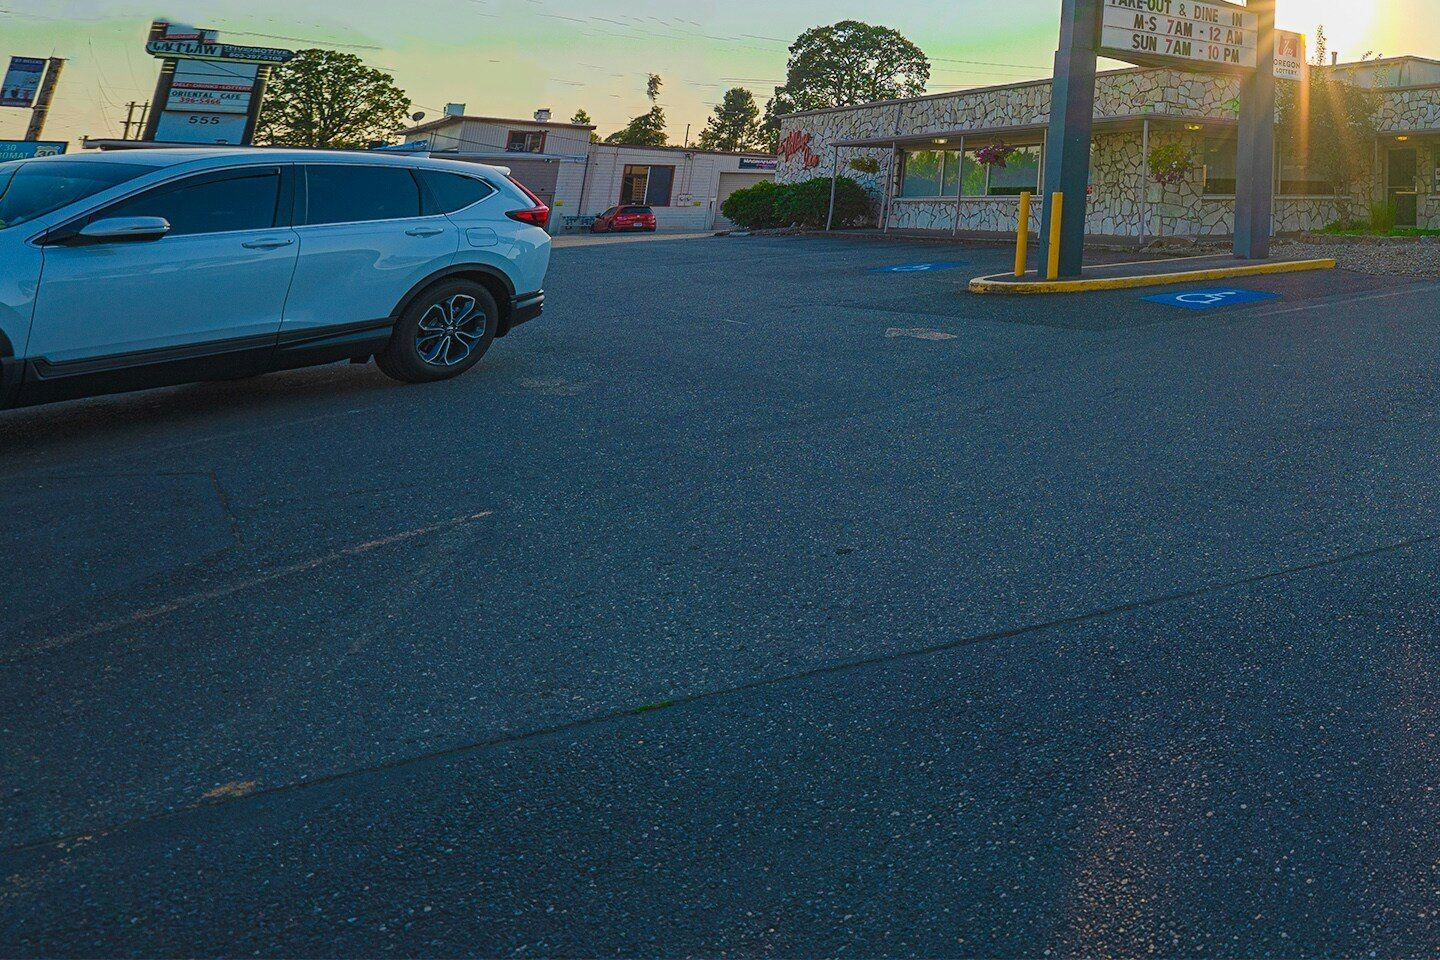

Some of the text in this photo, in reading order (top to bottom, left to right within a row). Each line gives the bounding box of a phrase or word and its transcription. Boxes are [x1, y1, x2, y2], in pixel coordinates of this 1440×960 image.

[1178, 3, 1187, 17] &
[1194, 5, 1218, 23] DINE
[1232, 12, 1243, 27] IN
[1167, 19, 1193, 37] 7AM
[1209, 26, 1221, 42] 12
[1226, 29, 1243, 46] AM
[1131, 34, 1157, 51] SUN
[1165, 39, 1192, 57] 7AM
[1207, 45, 1220, 60] 10
[1224, 48, 1240, 63] PM
[1273, 58, 1300, 69] OREGON
[1276, 67, 1297, 75] LOTTERY
[171, 90, 242, 100] ORIENTAL CAFE
[188, 115, 220, 125] 555
